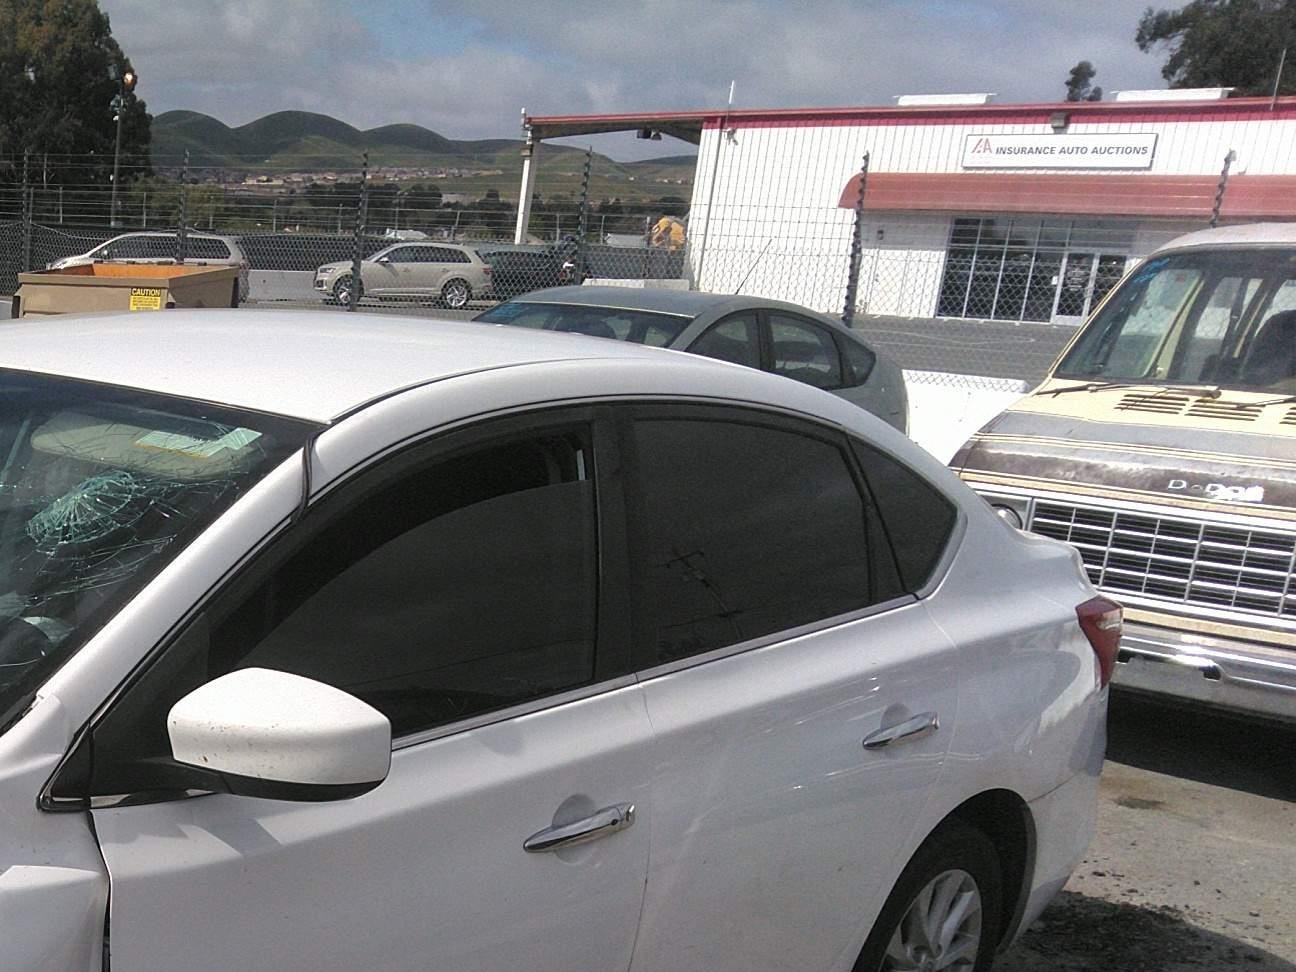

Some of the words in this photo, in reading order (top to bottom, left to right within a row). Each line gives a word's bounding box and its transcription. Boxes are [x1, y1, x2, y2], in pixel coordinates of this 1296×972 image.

[995, 146, 1057, 155] INSURANCE
[1058, 146, 1088, 155] AUTO
[1091, 146, 1148, 155] AUCTIONS
[131, 288, 160, 296] CAUTION
